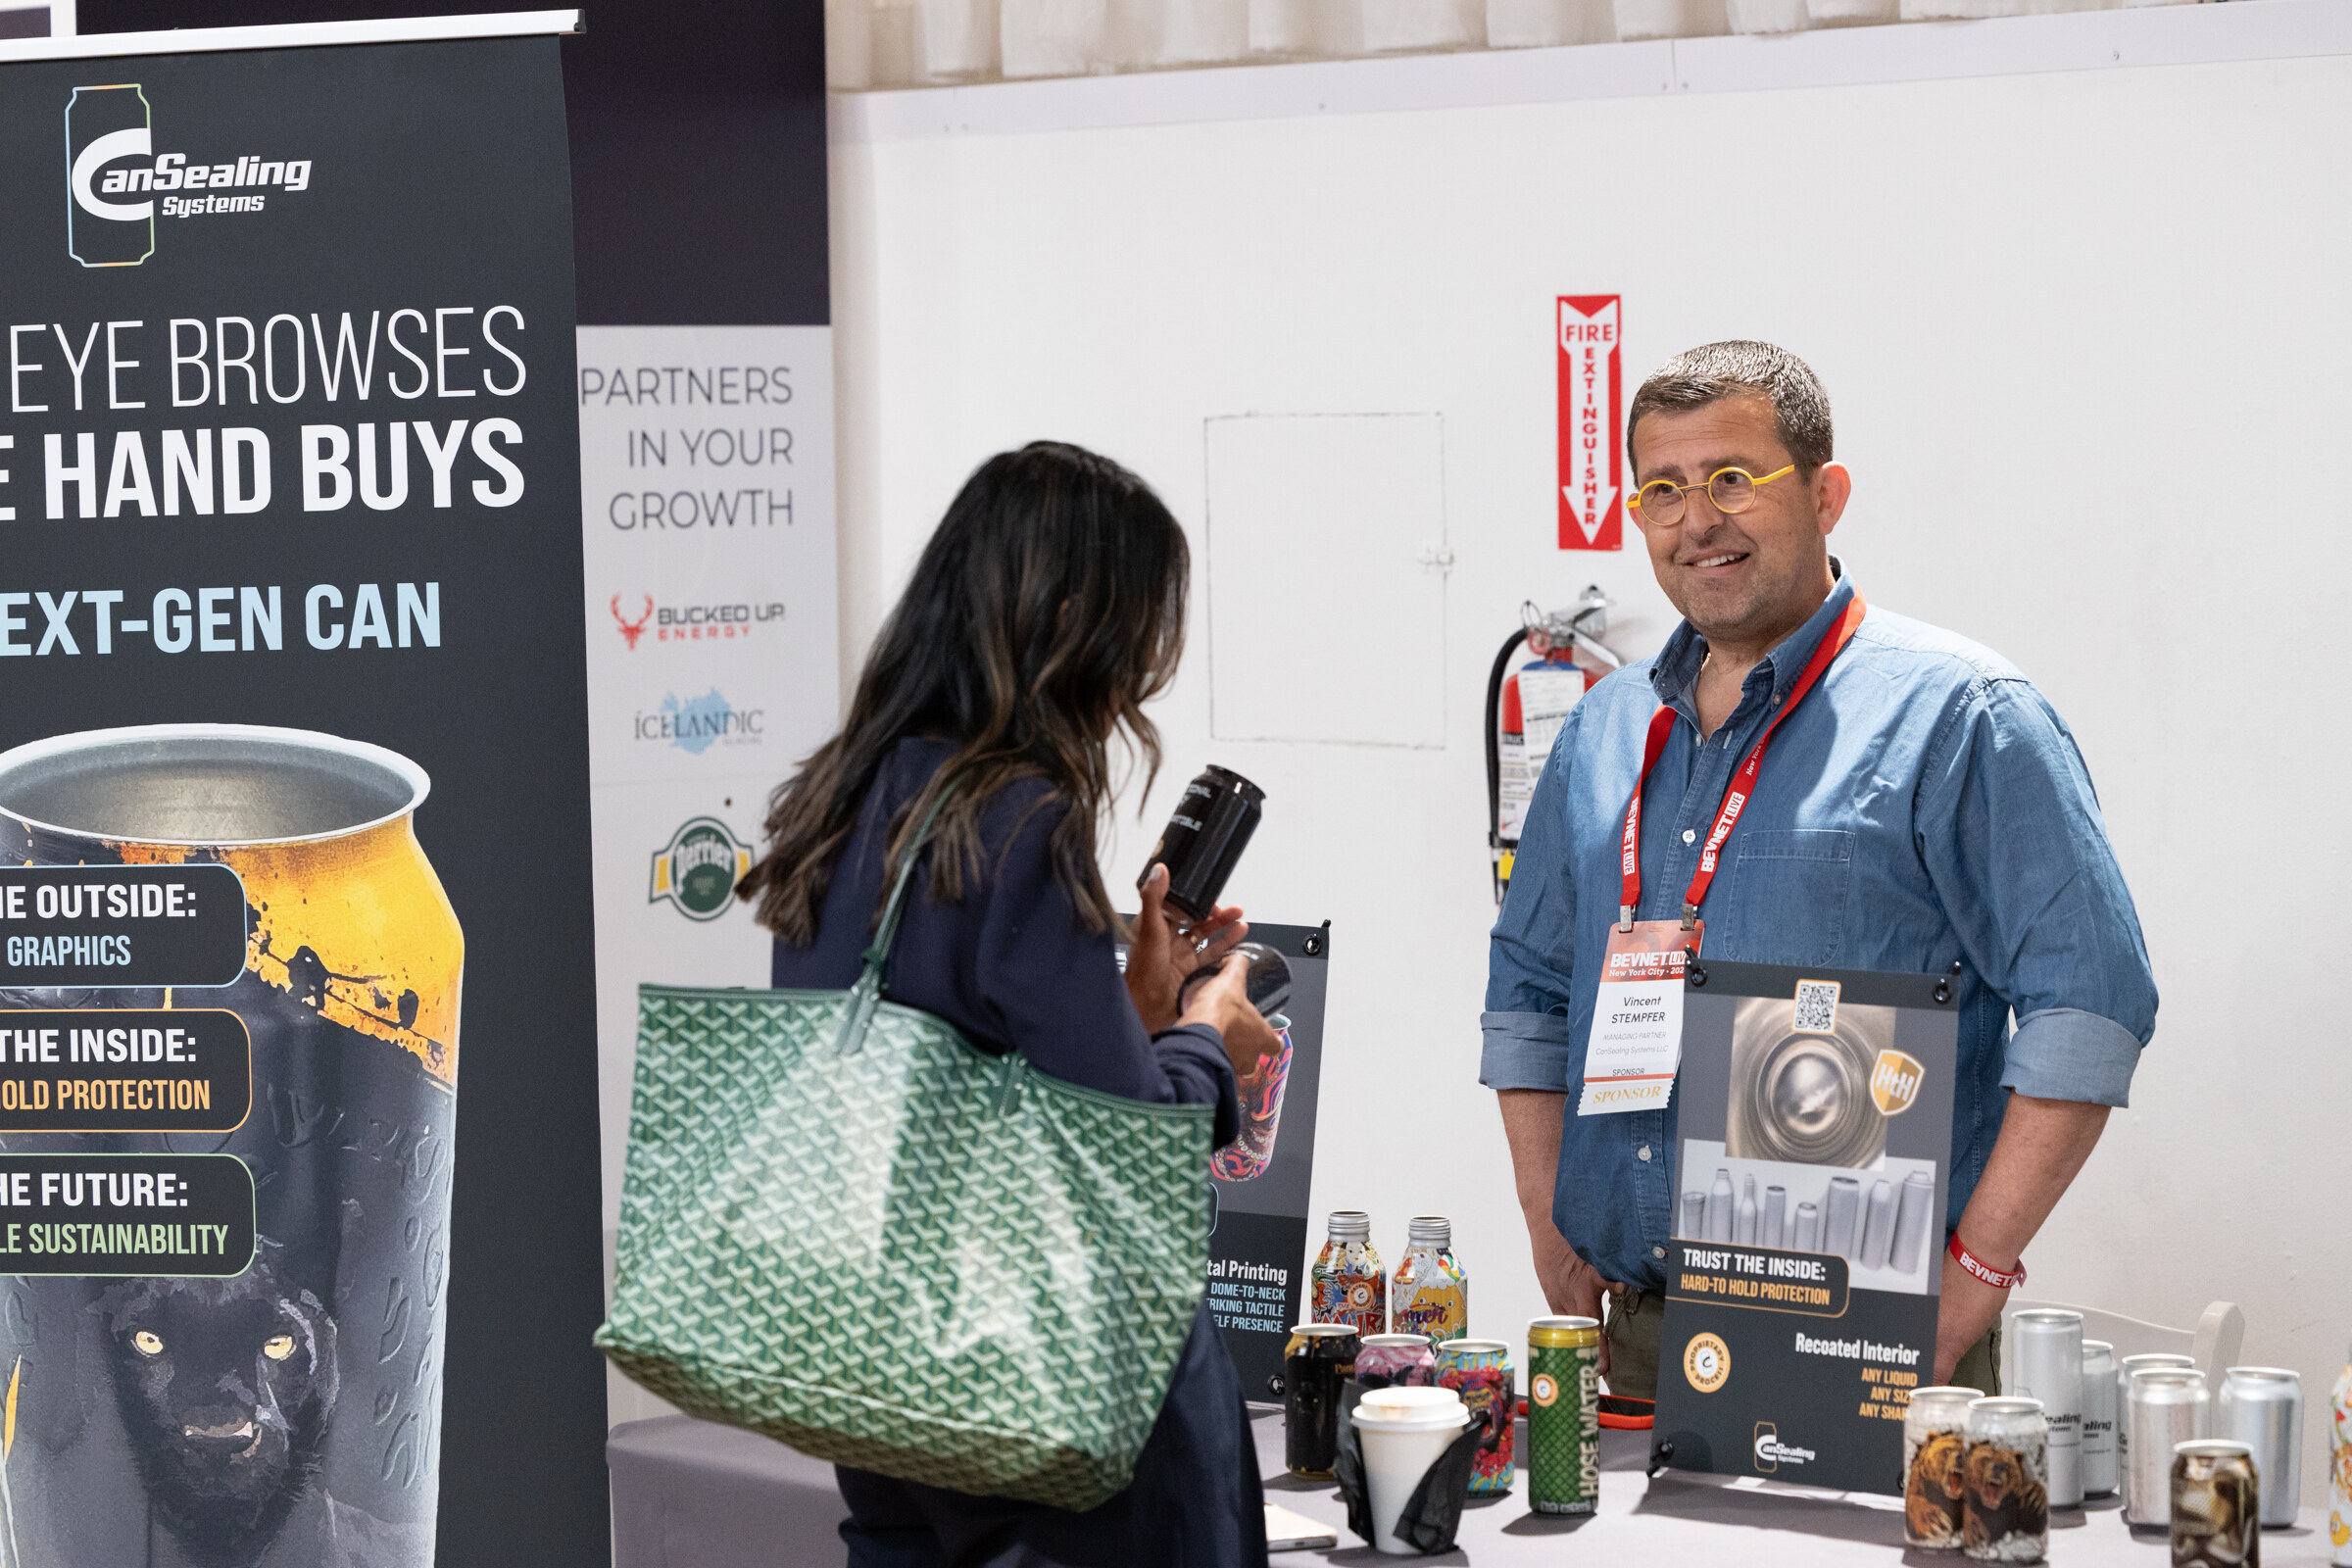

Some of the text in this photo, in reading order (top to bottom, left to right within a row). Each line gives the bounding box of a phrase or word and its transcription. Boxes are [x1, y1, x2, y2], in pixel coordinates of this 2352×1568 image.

[72, 127, 312, 220] CanSealing
[162, 194, 265, 219] Systems
[1565, 324, 1613, 342] FIRE
[10, 305, 527, 413] EYE BROWSES
[581, 367, 793, 406] PARTNERS
[628, 427, 794, 467] IN YOUR
[1582, 347, 1597, 524] EXTINGUISHER
[43, 426, 271, 519] HAND
[301, 417, 525, 513] BUYS
[609, 489, 793, 530] GROWTH
[305, 582, 441, 651] CAN
[658, 603, 785, 625] BUCKED UP
[658, 625, 751, 641] ENERGY
[1700, 792, 1745, 872] BEVNET.LIVE
[0, 884, 196, 919] E OUTSIDE:
[7, 935, 131, 966] GRAPHICS
[1610, 951, 1687, 967] BEVNET.LIV
[1647, 967, 1665, 976] City
[1624, 996, 1661, 1006] Vincent
[1611, 1012, 1666, 1023] STEMPFER
[0, 1028, 196, 1062] THE INSIDE:
[57, 1080, 211, 1109] PROTECTION
[1592, 1086, 1661, 1104] SPONSOR
[41, 1173, 188, 1206] FUTURE:
[28, 1223, 228, 1254] SUSTAINABILITY
[1228, 1260, 1288, 1286] Printing
[1683, 1249, 1827, 1281] TRUST THE INSIDE:
[1210, 1282, 1286, 1301] DOME-TO-NECK
[1681, 1273, 1831, 1305] HARD-TO HOLD PROTECTION
[1206, 1298, 1285, 1317] RIKING TACTILE
[1232, 1316, 1284, 1333] PRESENCE
[1690, 1340, 1724, 1372] PROPRIETARY
[1795, 1332, 1921, 1365] Recoated Interior
[1861, 1367, 1918, 1387] ANY LIQUID
[1858, 1401, 1881, 1418] ANY
[1870, 1386, 1891, 1402] ANY
[1579, 1363, 1600, 1496] HOSE WATER
